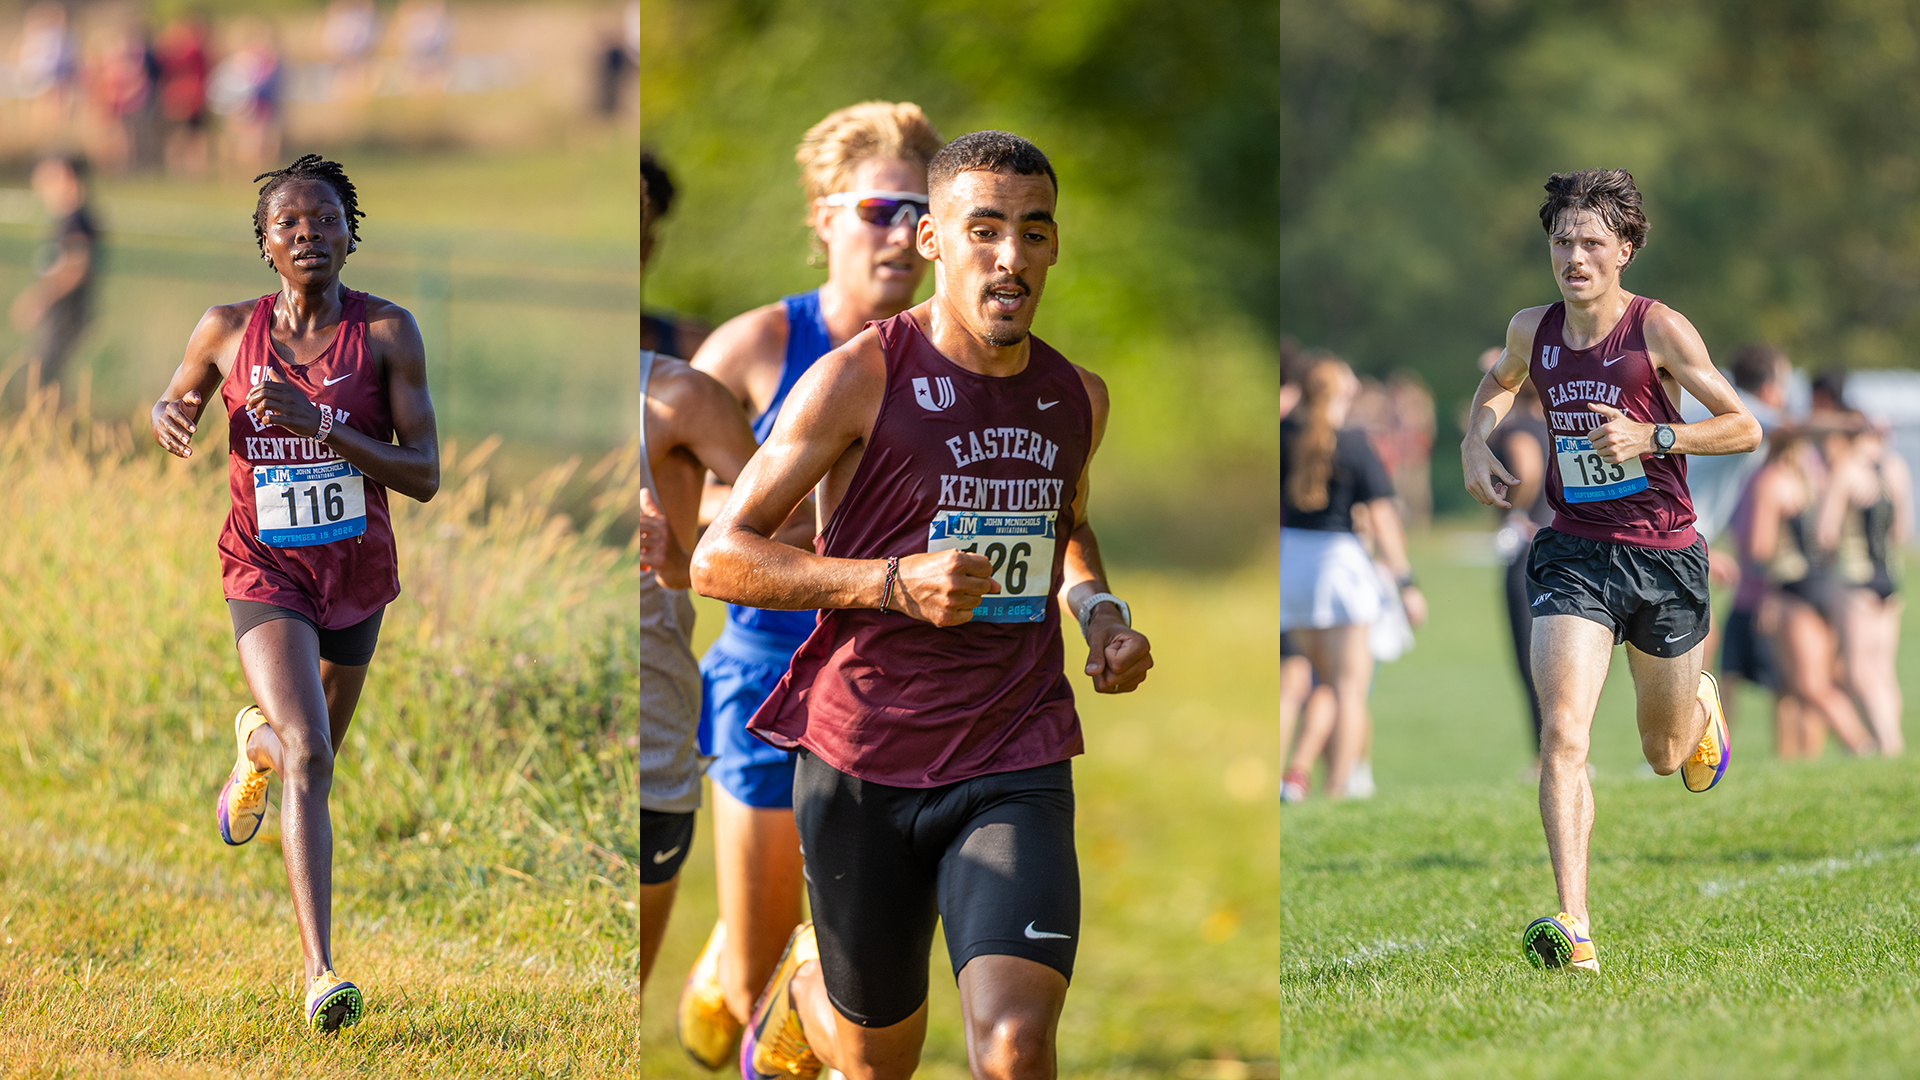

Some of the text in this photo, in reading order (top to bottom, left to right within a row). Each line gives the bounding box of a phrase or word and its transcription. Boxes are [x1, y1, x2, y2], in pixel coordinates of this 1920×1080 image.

[1548, 381, 1621, 407] EASTERN
[1549, 408, 1629, 431] KENTUC
[946, 427, 1059, 471] EASTERN
[1566, 440, 1578, 450] JM
[272, 469, 291, 482] JM
[306, 472, 335, 480] INVITATIONAL
[1573, 454, 1625, 486] 133
[938, 475, 1064, 511] KENTUCKY
[1573, 490, 1606, 499] SEPTEMBER
[281, 483, 344, 526] 116
[953, 517, 978, 535] JM
[984, 518, 1003, 527] JOHN
[995, 526, 1029, 534] INVITATIONAL
[272, 532, 317, 544] SEPTEMBER
[332, 525, 354, 537] 2026
[961, 542, 1031, 595] 26
[1007, 604, 1033, 616] 2026
